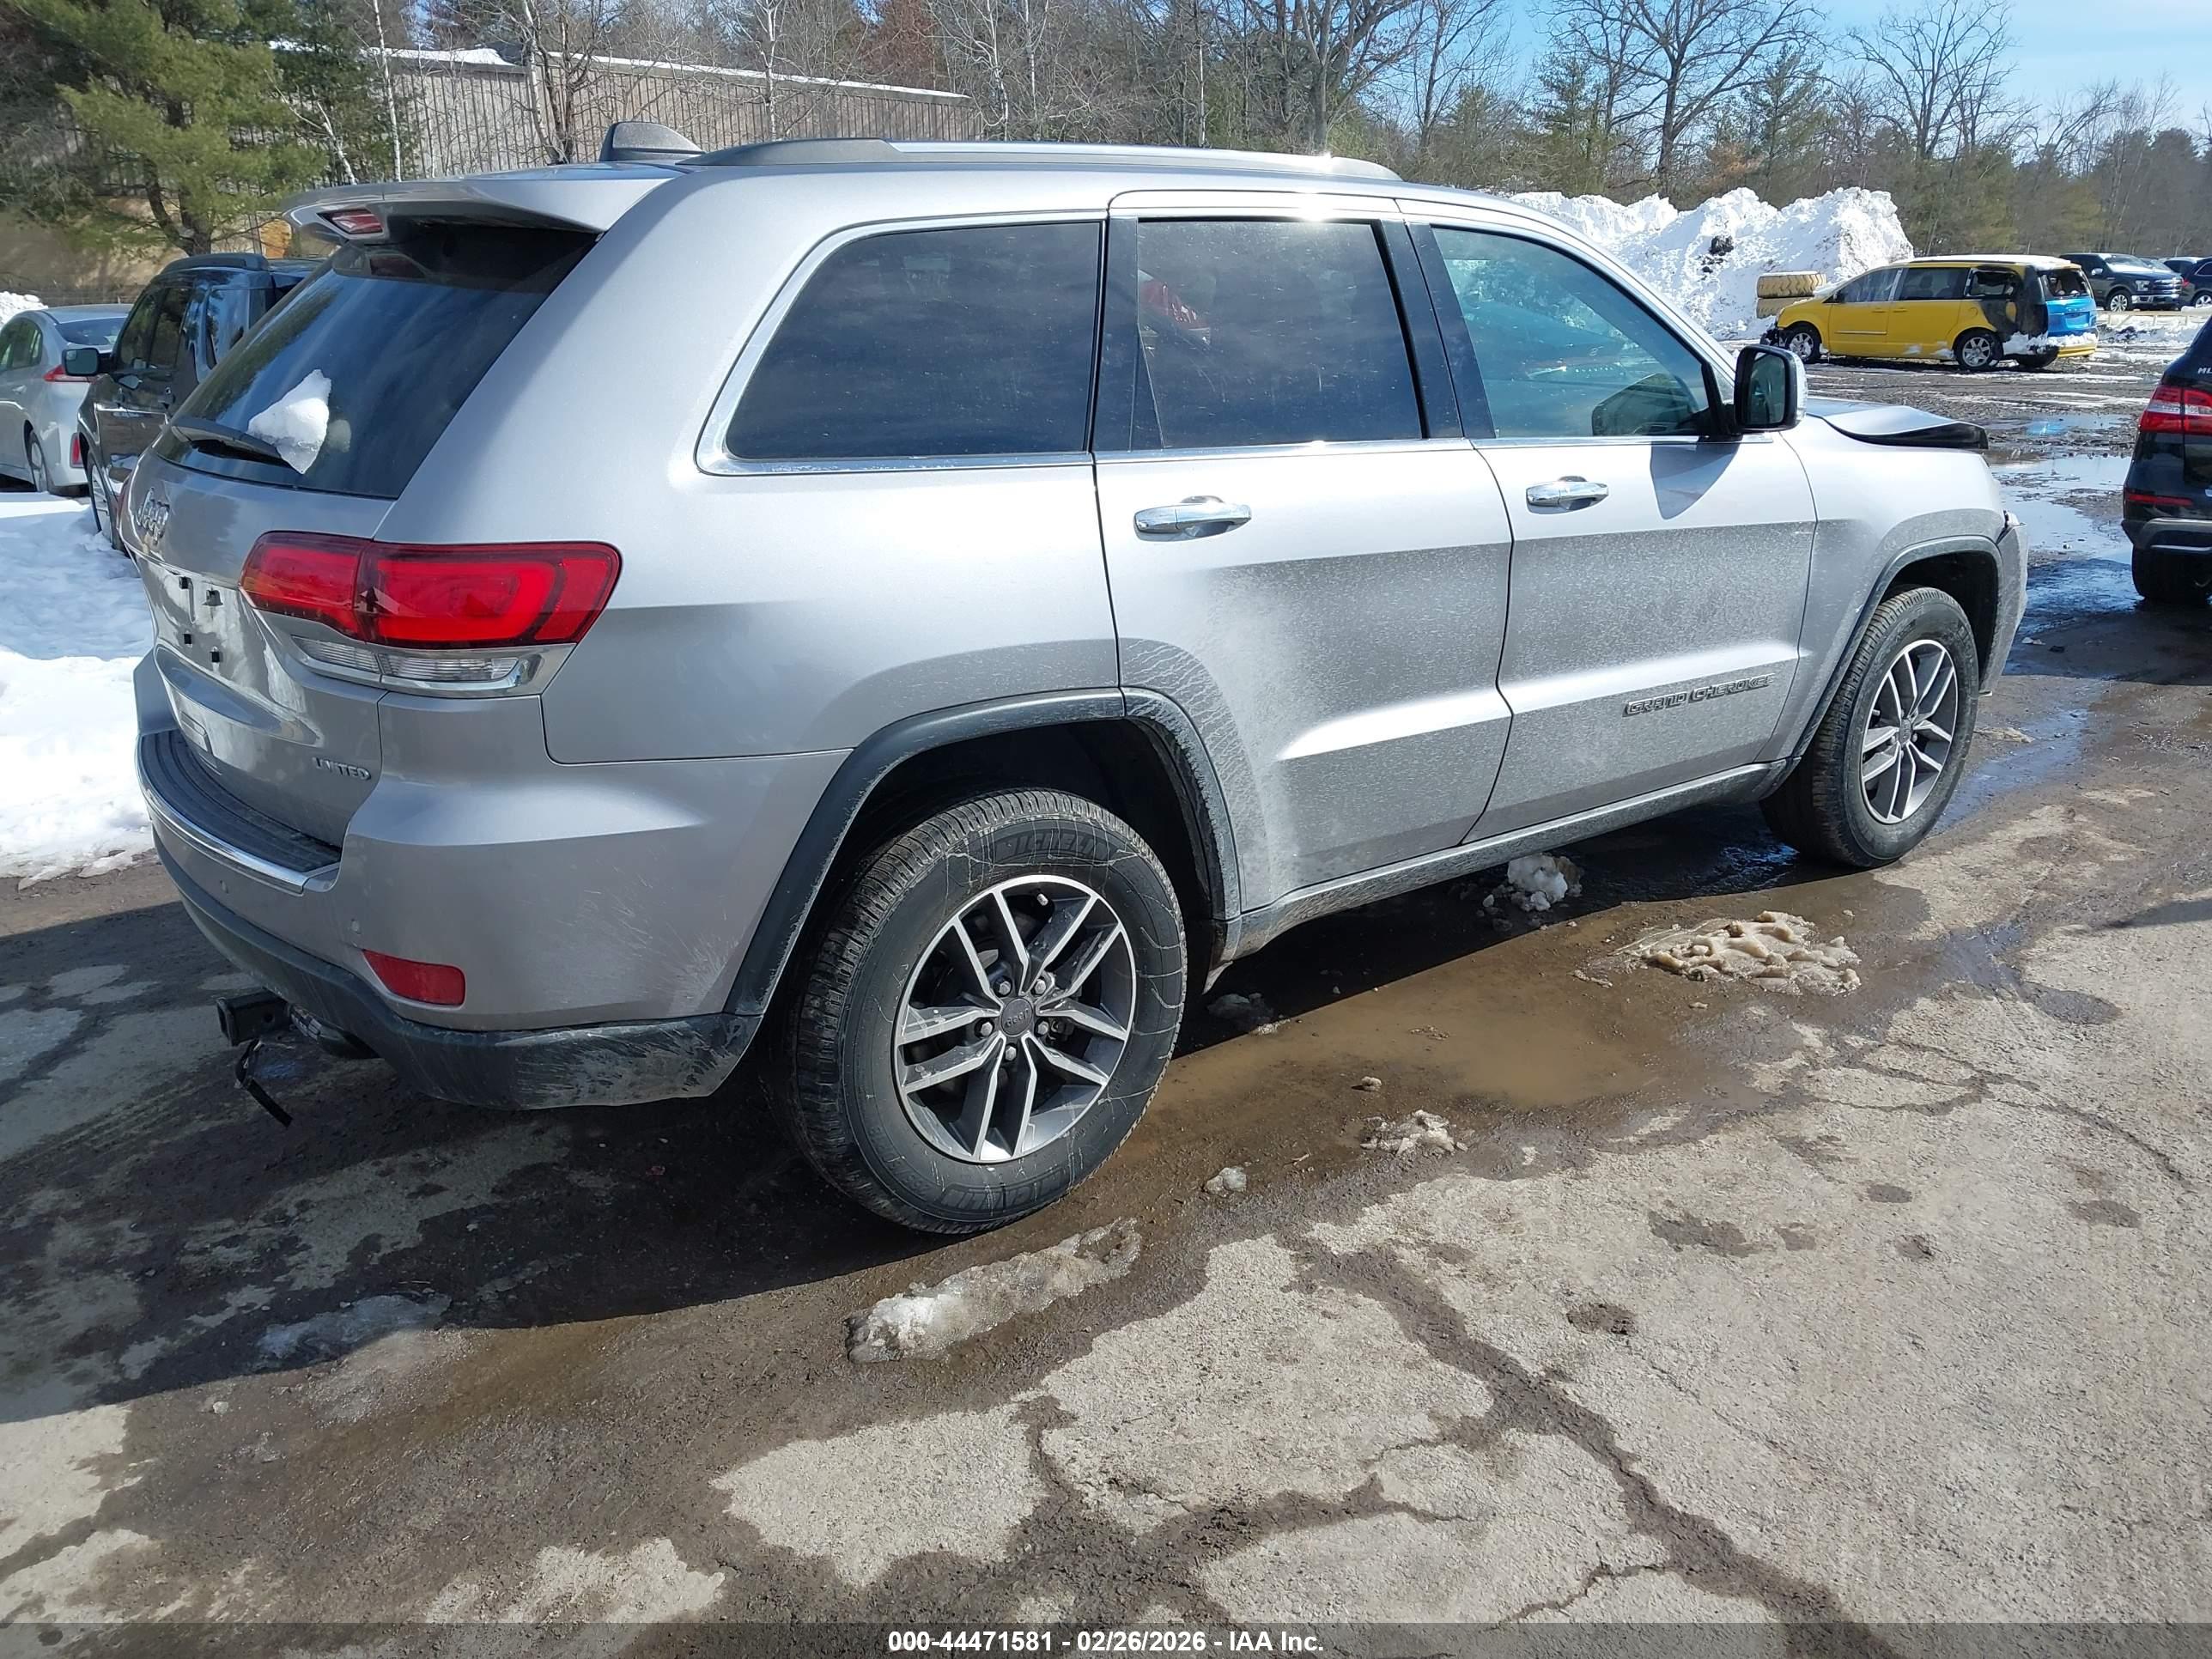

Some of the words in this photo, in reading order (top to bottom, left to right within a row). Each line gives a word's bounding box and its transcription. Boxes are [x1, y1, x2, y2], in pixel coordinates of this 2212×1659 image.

[137, 487, 170, 544] Jeep
[1622, 690, 1687, 717] GRAND
[1688, 673, 1776, 703] CHEROKEE
